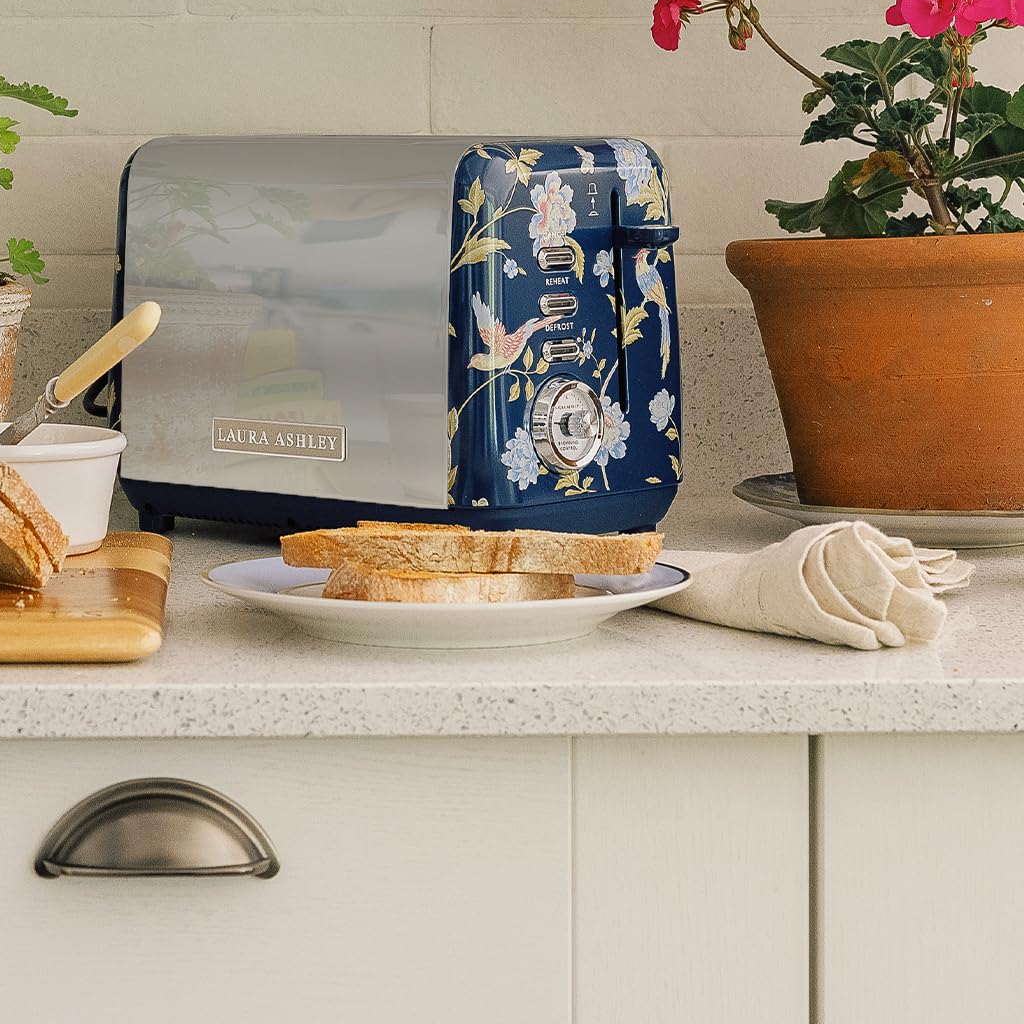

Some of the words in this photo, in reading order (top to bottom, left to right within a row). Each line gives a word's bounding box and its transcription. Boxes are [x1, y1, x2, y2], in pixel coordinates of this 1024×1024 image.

[545, 276, 570, 286] REHEAT
[545, 322, 574, 332] DEFROST
[217, 428, 270, 446] LAURA
[274, 432, 338, 451] ASHLEY
